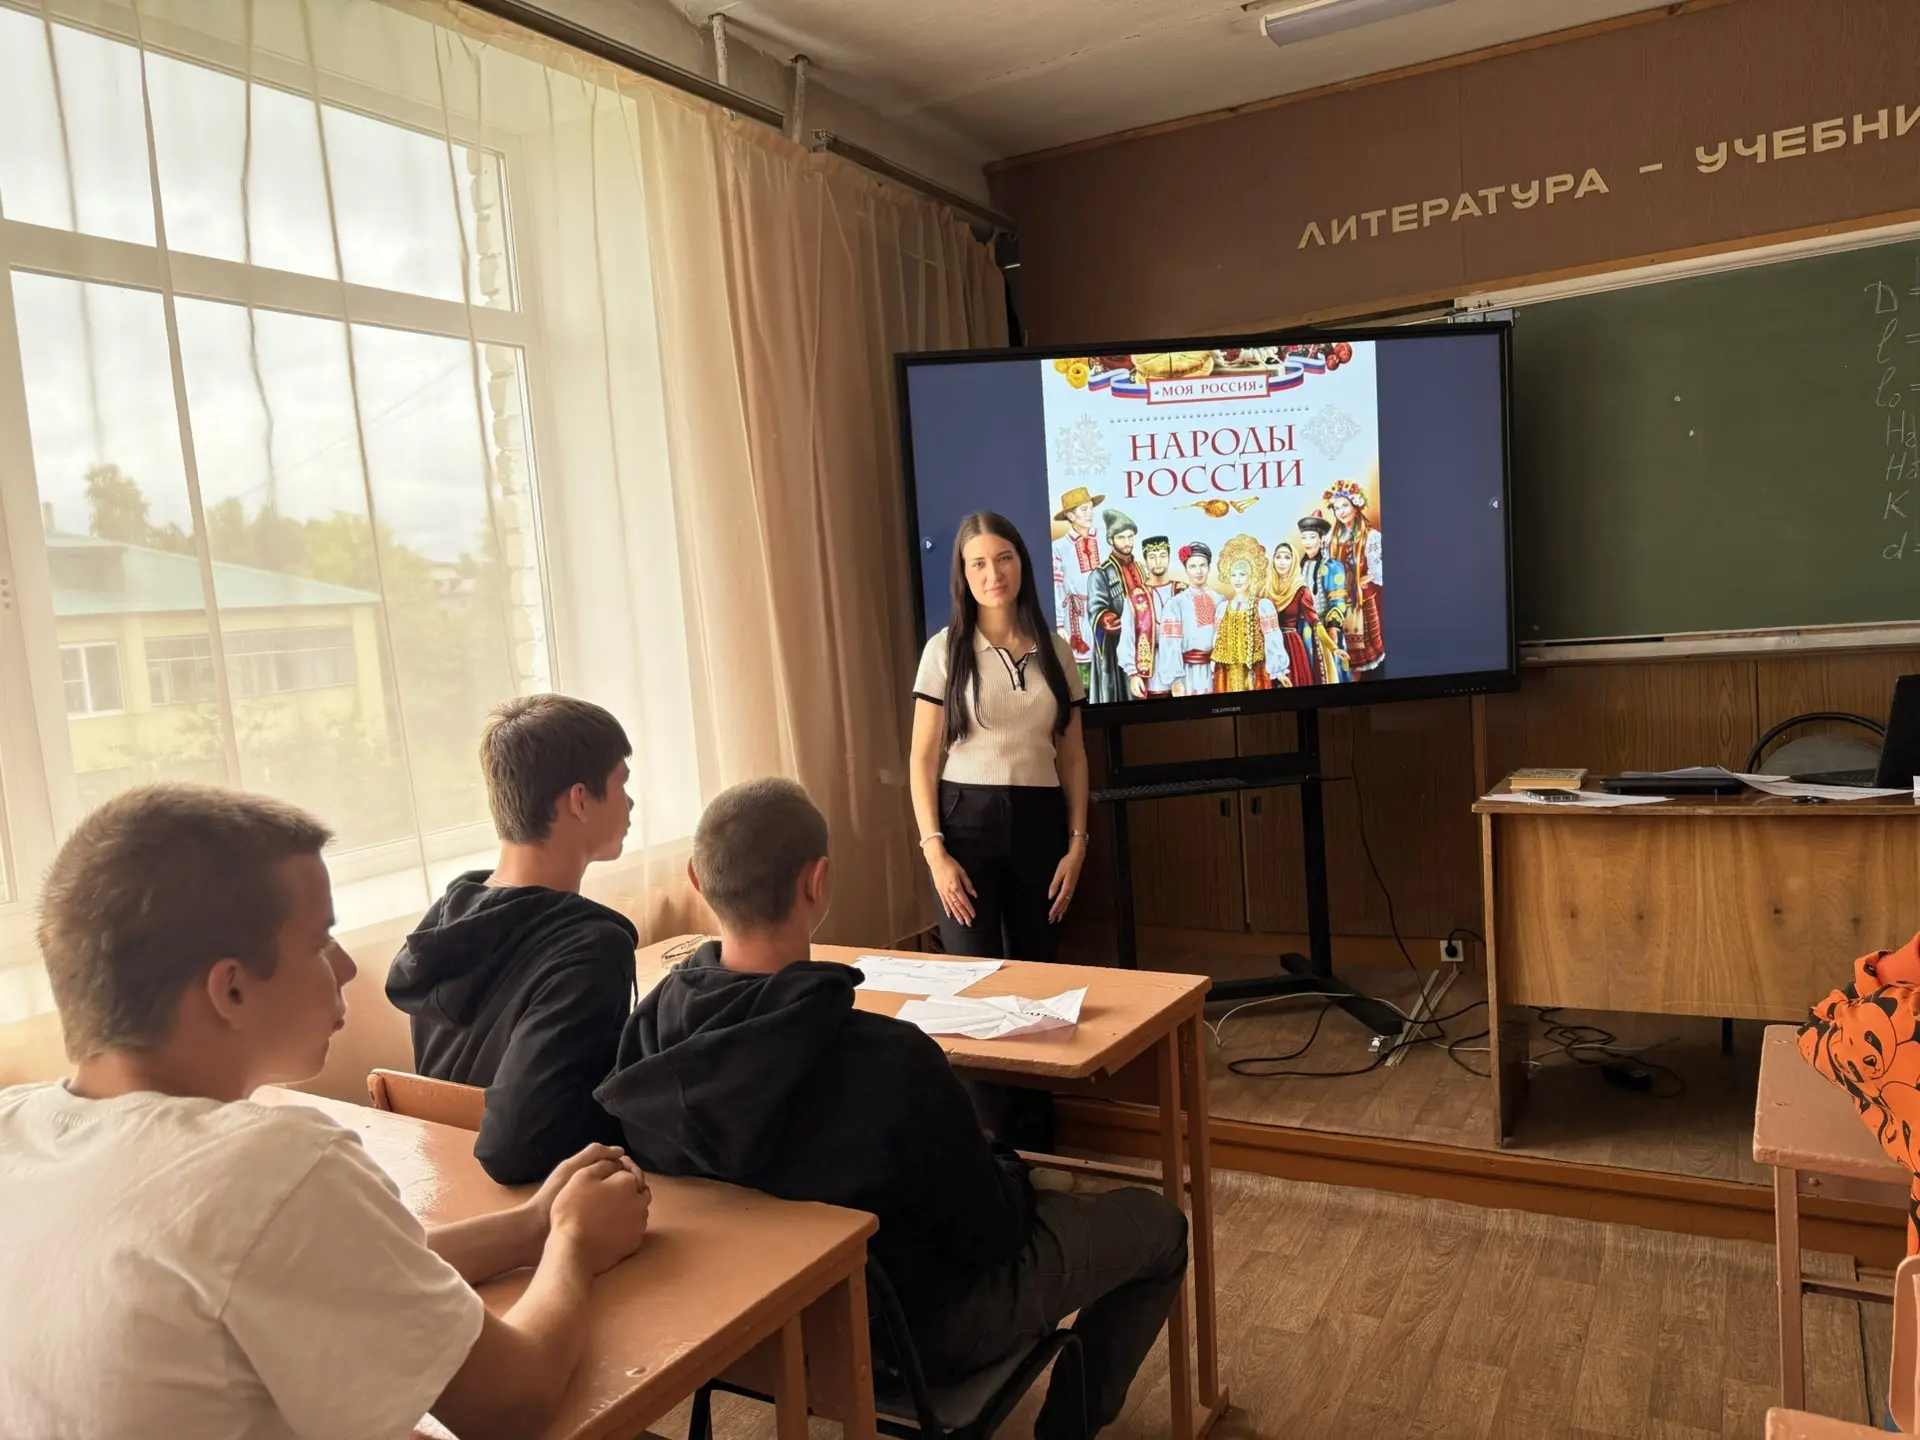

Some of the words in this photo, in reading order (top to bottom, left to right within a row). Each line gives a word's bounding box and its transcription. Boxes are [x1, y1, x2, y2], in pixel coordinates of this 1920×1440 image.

[1297, 167, 1610, 249] ЛИТЕРАТУРА
[1695, 104, 1920, 174] УЧЕБНИ
[1162, 384, 1194, 397] МОЯ
[1201, 381, 1258, 395] РОССИЯ
[1128, 424, 1298, 461] НАРОДЫ
[1124, 459, 1305, 499] РОССИИ
